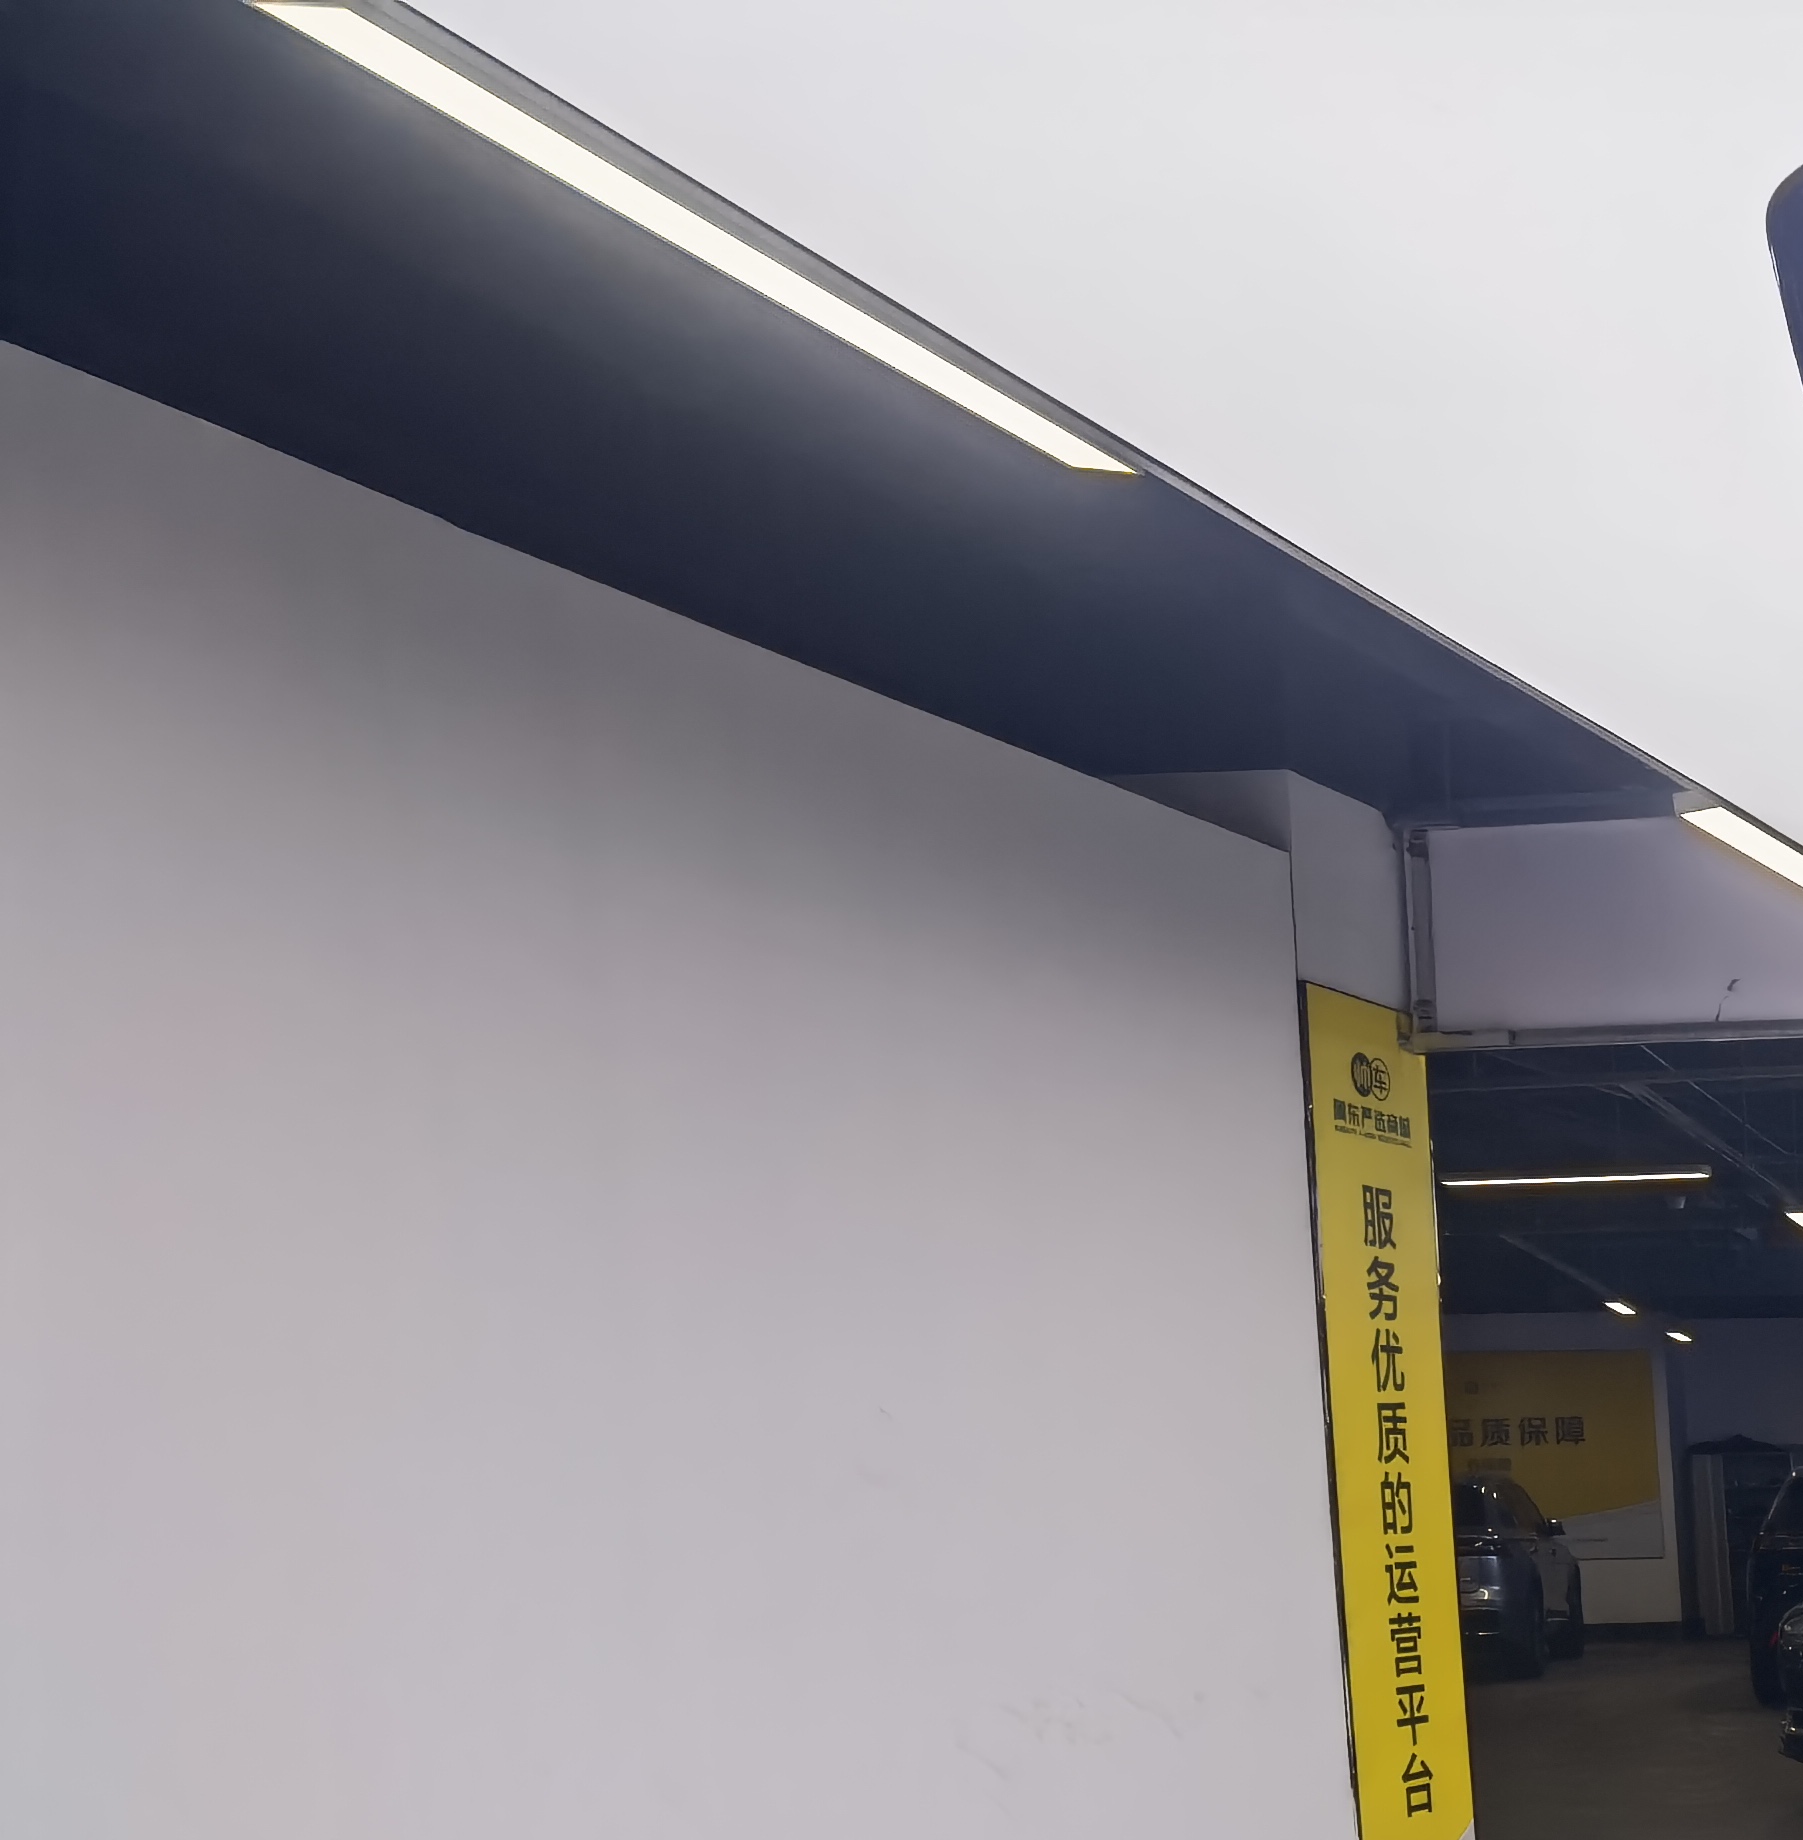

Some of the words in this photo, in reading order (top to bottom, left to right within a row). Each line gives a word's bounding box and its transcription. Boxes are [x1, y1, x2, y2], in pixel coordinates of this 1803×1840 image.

[1361, 1184, 1434, 1818] 服务优质的运营平台
